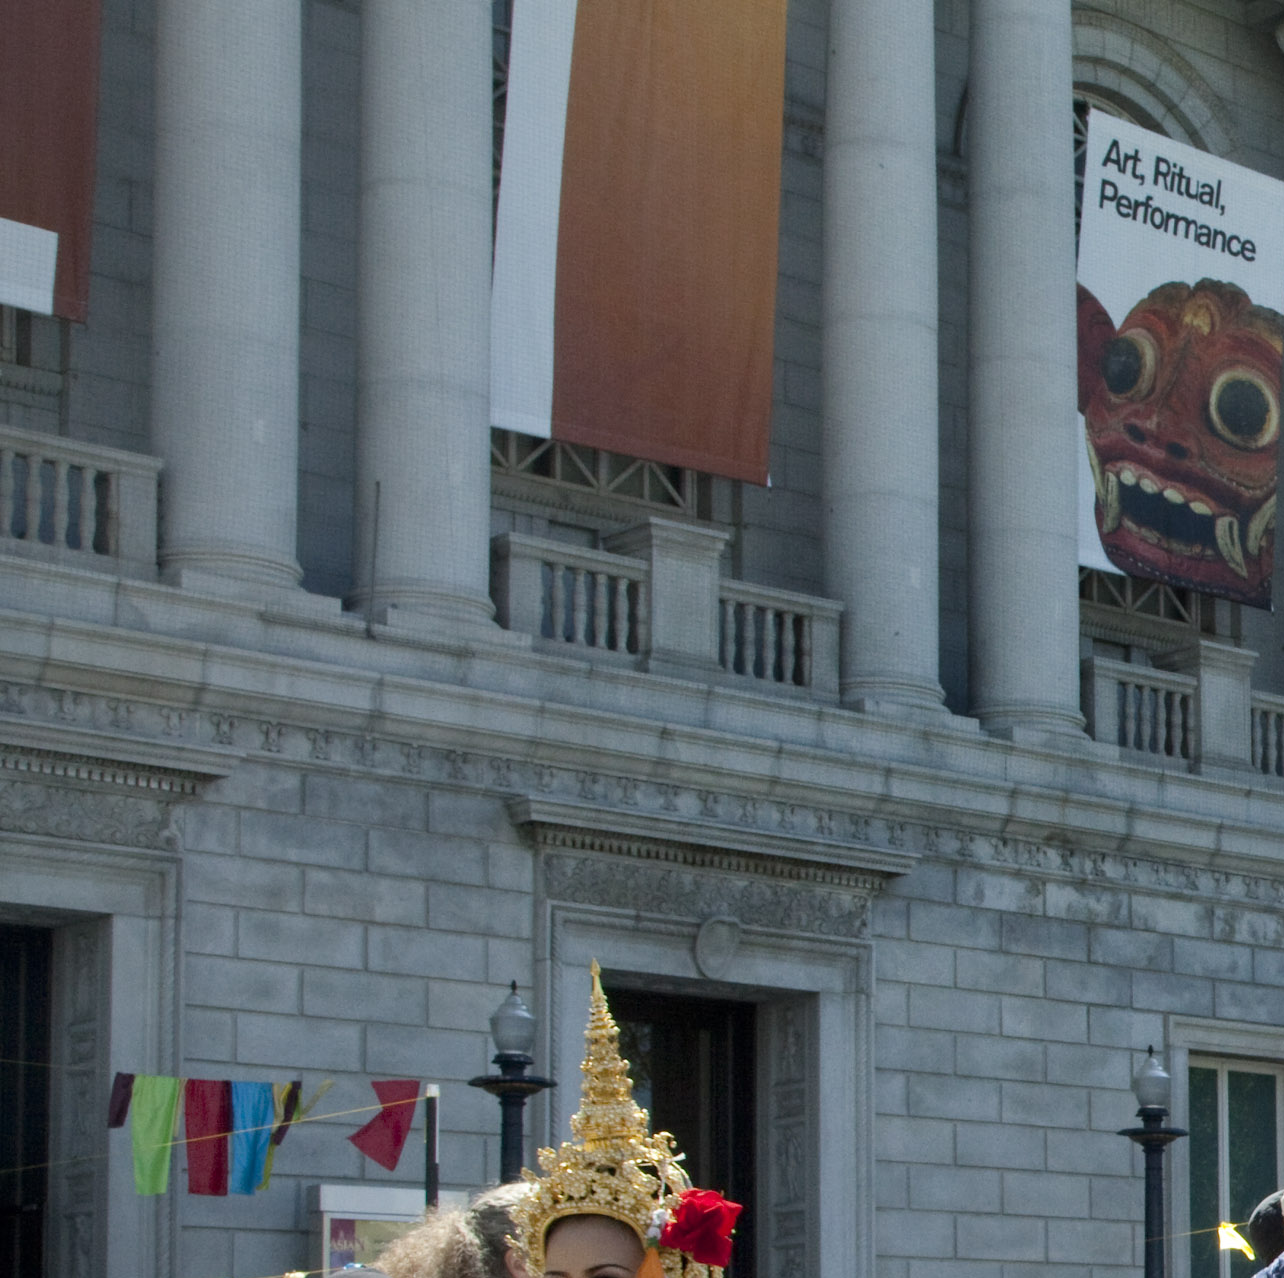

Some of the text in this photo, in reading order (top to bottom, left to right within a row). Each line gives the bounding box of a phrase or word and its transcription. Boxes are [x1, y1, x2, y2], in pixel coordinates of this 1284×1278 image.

[1101, 138, 1226, 216] Art, Ritual,
[1098, 179, 1257, 263] Performance
